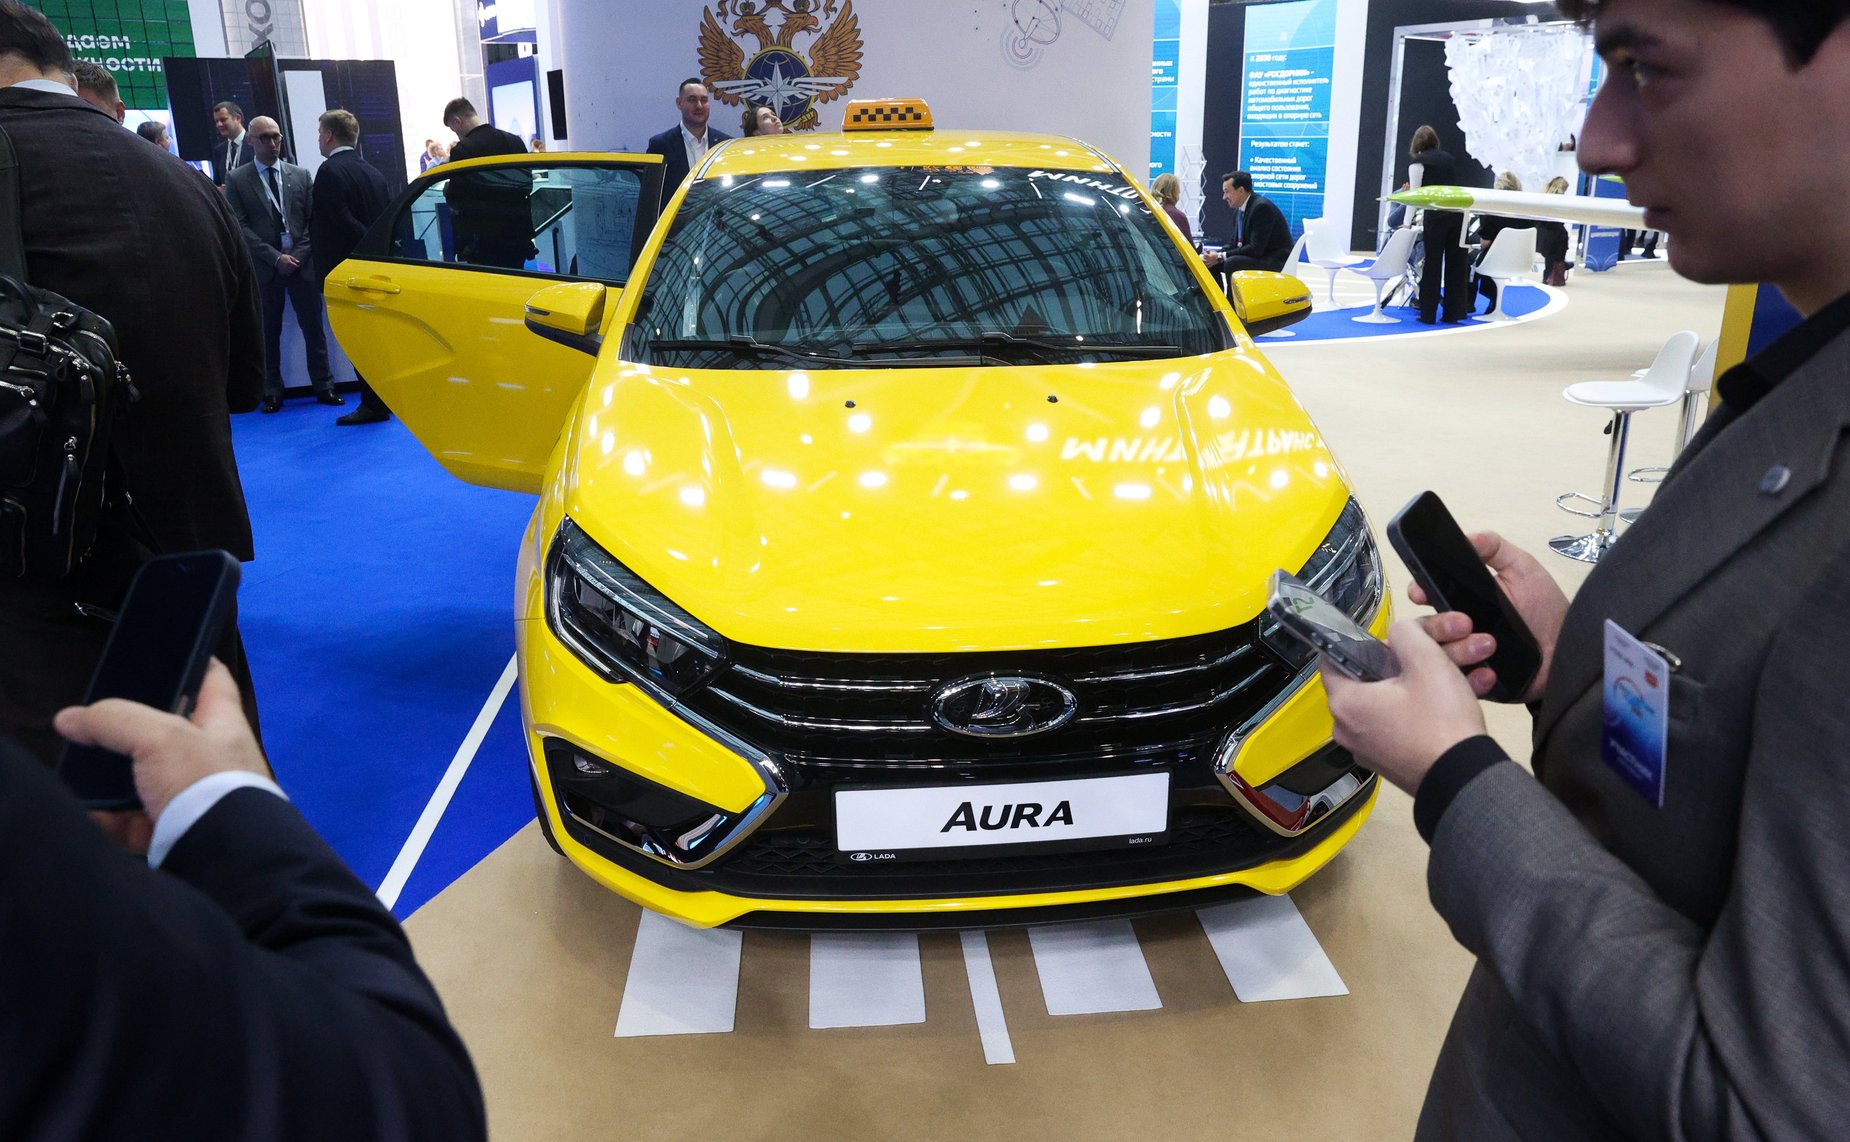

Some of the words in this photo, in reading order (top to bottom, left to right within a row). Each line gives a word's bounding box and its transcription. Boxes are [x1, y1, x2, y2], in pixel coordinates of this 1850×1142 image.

[1248, 79, 1292, 88] единственный
[1292, 78, 1329, 86] исполнитель
[1248, 88, 1267, 96] работ
[1276, 87, 1313, 95] диагностике
[1283, 112, 1309, 120] опорную
[1250, 140, 1288, 148] Результатом
[1289, 174, 1306, 182] дорог
[1284, 182, 1318, 190] сооружений
[940, 800, 1074, 833] AURA
[1128, 836, 1152, 844] lada.ru
